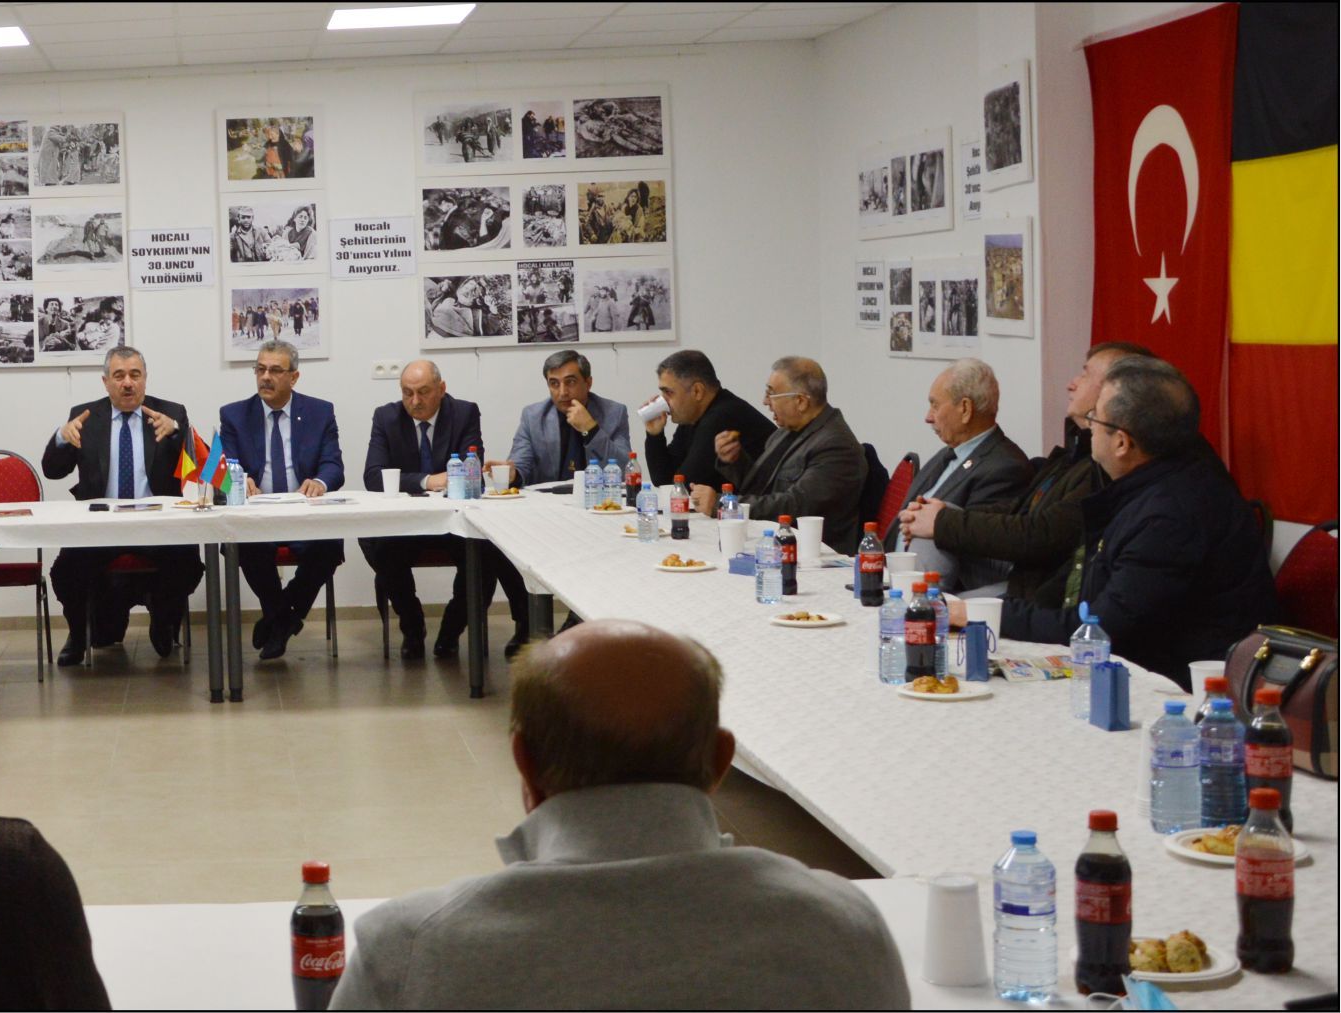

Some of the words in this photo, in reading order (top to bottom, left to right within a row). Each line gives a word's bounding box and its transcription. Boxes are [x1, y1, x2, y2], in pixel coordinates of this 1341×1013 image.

[354, 221, 390, 231] Hocalı
[151, 233, 190, 242] HOCALI
[340, 235, 406, 248] Şehitlerinin
[131, 246, 210, 256] SOYKIRIMI'NIN
[336, 251, 381, 260] 30'uncu
[383, 249, 412, 258] Yılını
[148, 260, 194, 270] 30.UNCU
[141, 272, 203, 284] YILDÖNÜMÜ
